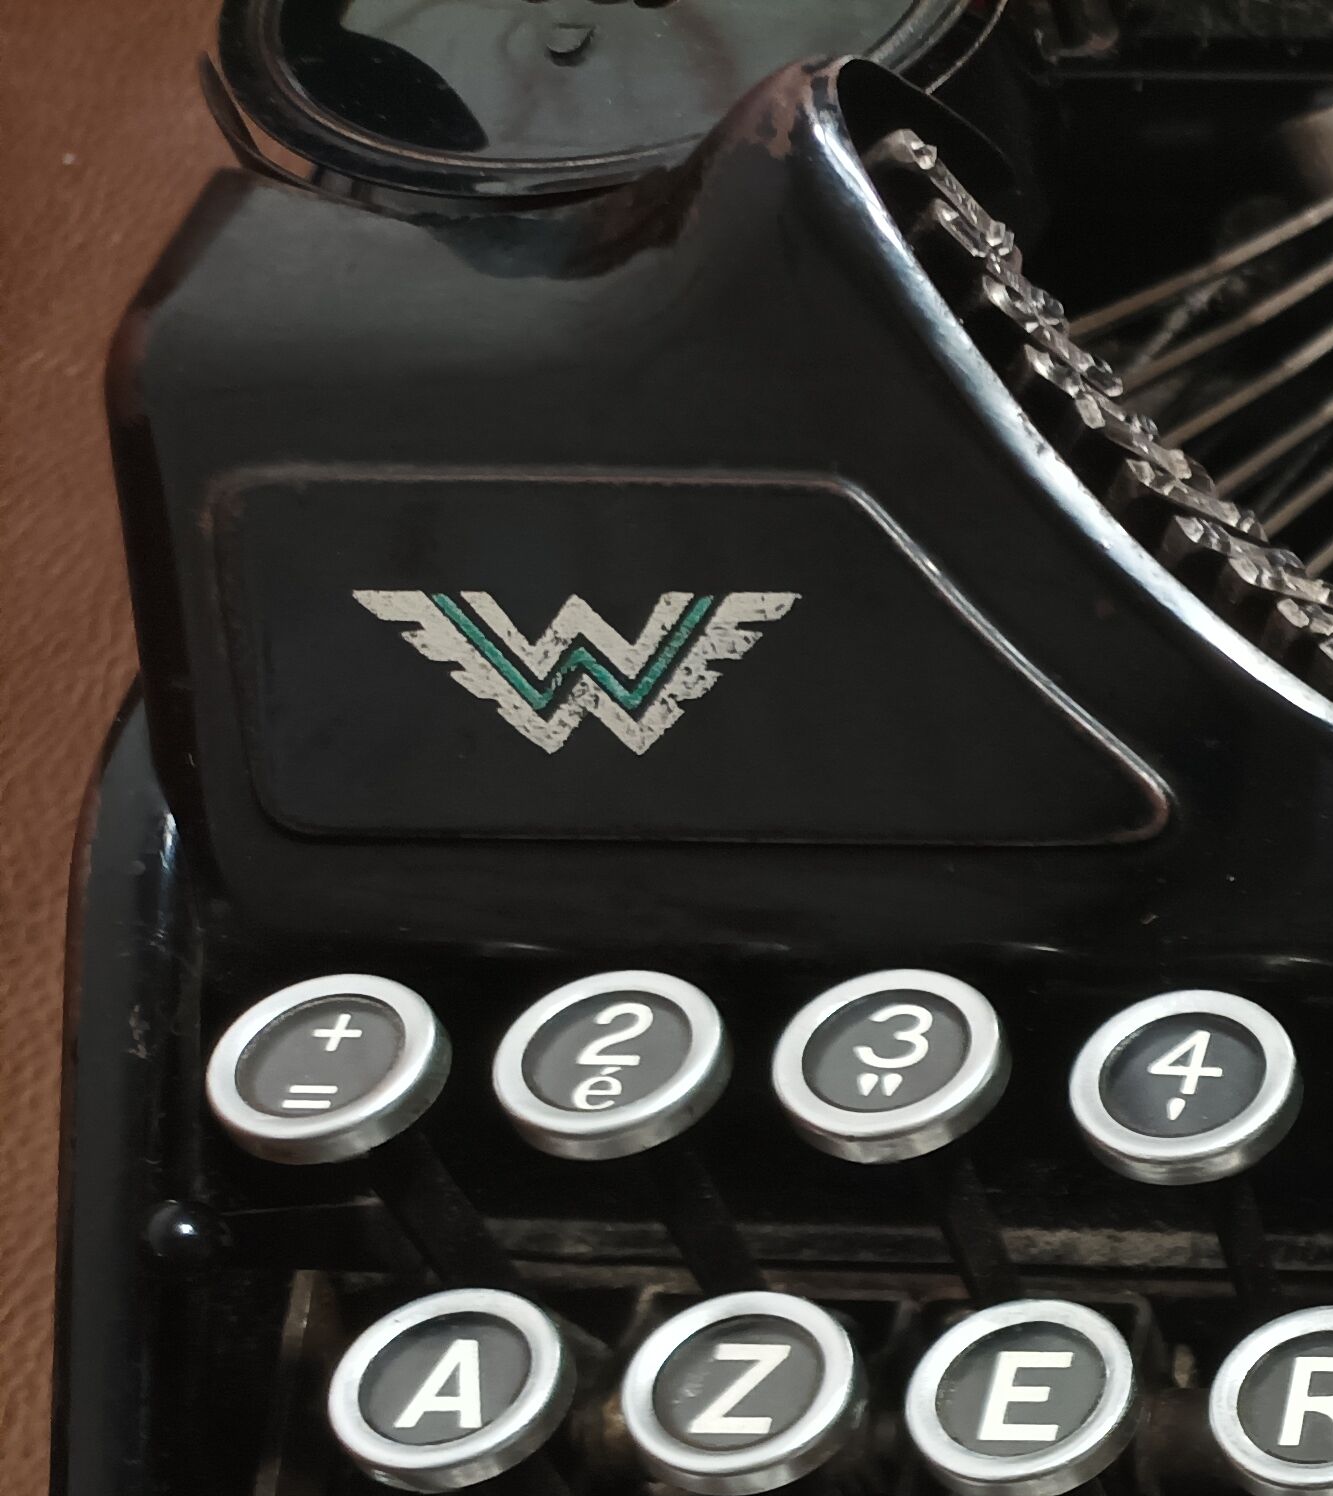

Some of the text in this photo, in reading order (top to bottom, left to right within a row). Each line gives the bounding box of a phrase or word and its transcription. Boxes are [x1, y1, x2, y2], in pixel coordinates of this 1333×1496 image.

[314, 1013, 362, 1052] +
[579, 1002, 653, 1066] 2
[855, 1003, 933, 1068] 3
[1149, 1030, 1222, 1094] 4
[282, 1085, 337, 1109] =
[574, 1068, 621, 1110] é
[395, 1340, 481, 1429] A
[691, 1344, 790, 1433] Z
[978, 1351, 1073, 1440] E
